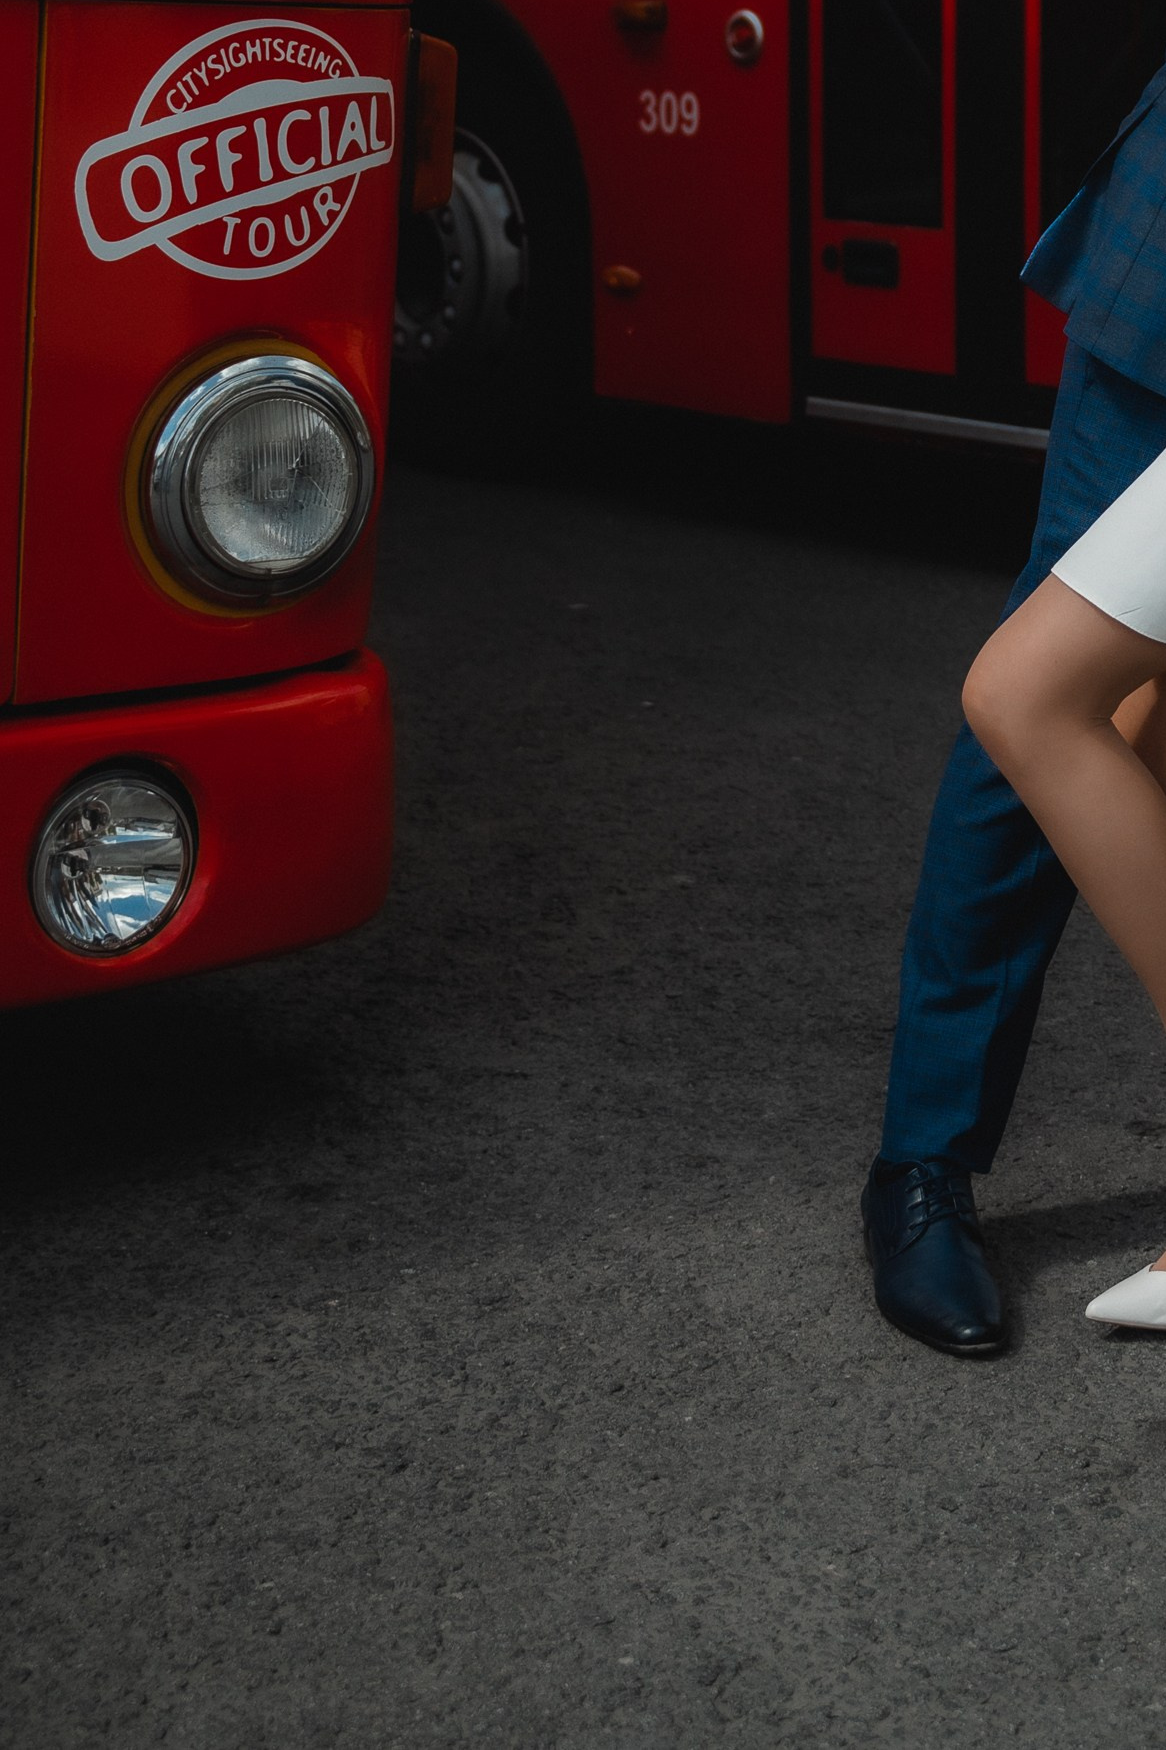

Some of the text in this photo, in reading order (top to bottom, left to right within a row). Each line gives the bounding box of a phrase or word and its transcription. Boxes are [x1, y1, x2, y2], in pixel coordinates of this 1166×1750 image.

[165, 37, 342, 115] CITYSIGHTSEEING
[639, 88, 699, 136] 309
[120, 95, 386, 224] OFFICIAL
[222, 186, 341, 258] TOUR
